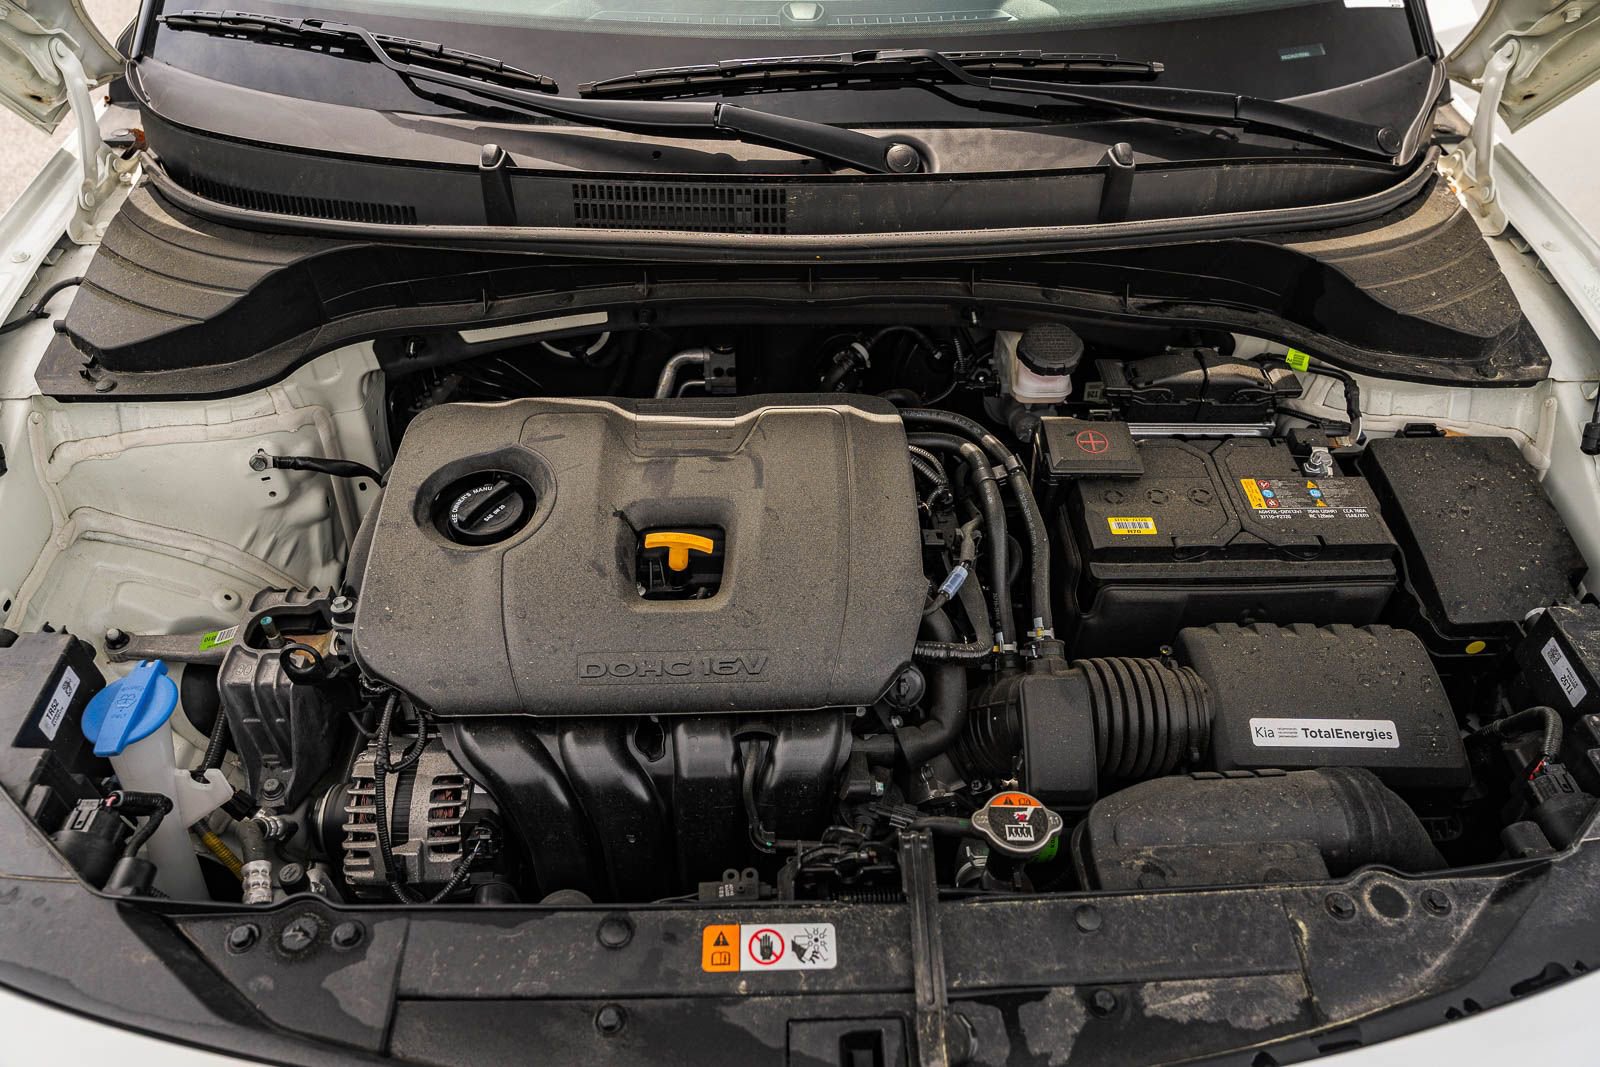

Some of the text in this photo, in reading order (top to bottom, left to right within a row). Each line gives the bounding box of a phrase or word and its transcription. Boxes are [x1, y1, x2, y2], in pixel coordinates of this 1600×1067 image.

[472, 486, 493, 494] MANU
[580, 656, 768, 679] DOHC 16V
[1560, 674, 1574, 695] TL52
[45, 698, 60, 721] TR52
[1254, 726, 1275, 738] Kia
[1301, 727, 1393, 741] TotalEnergies
